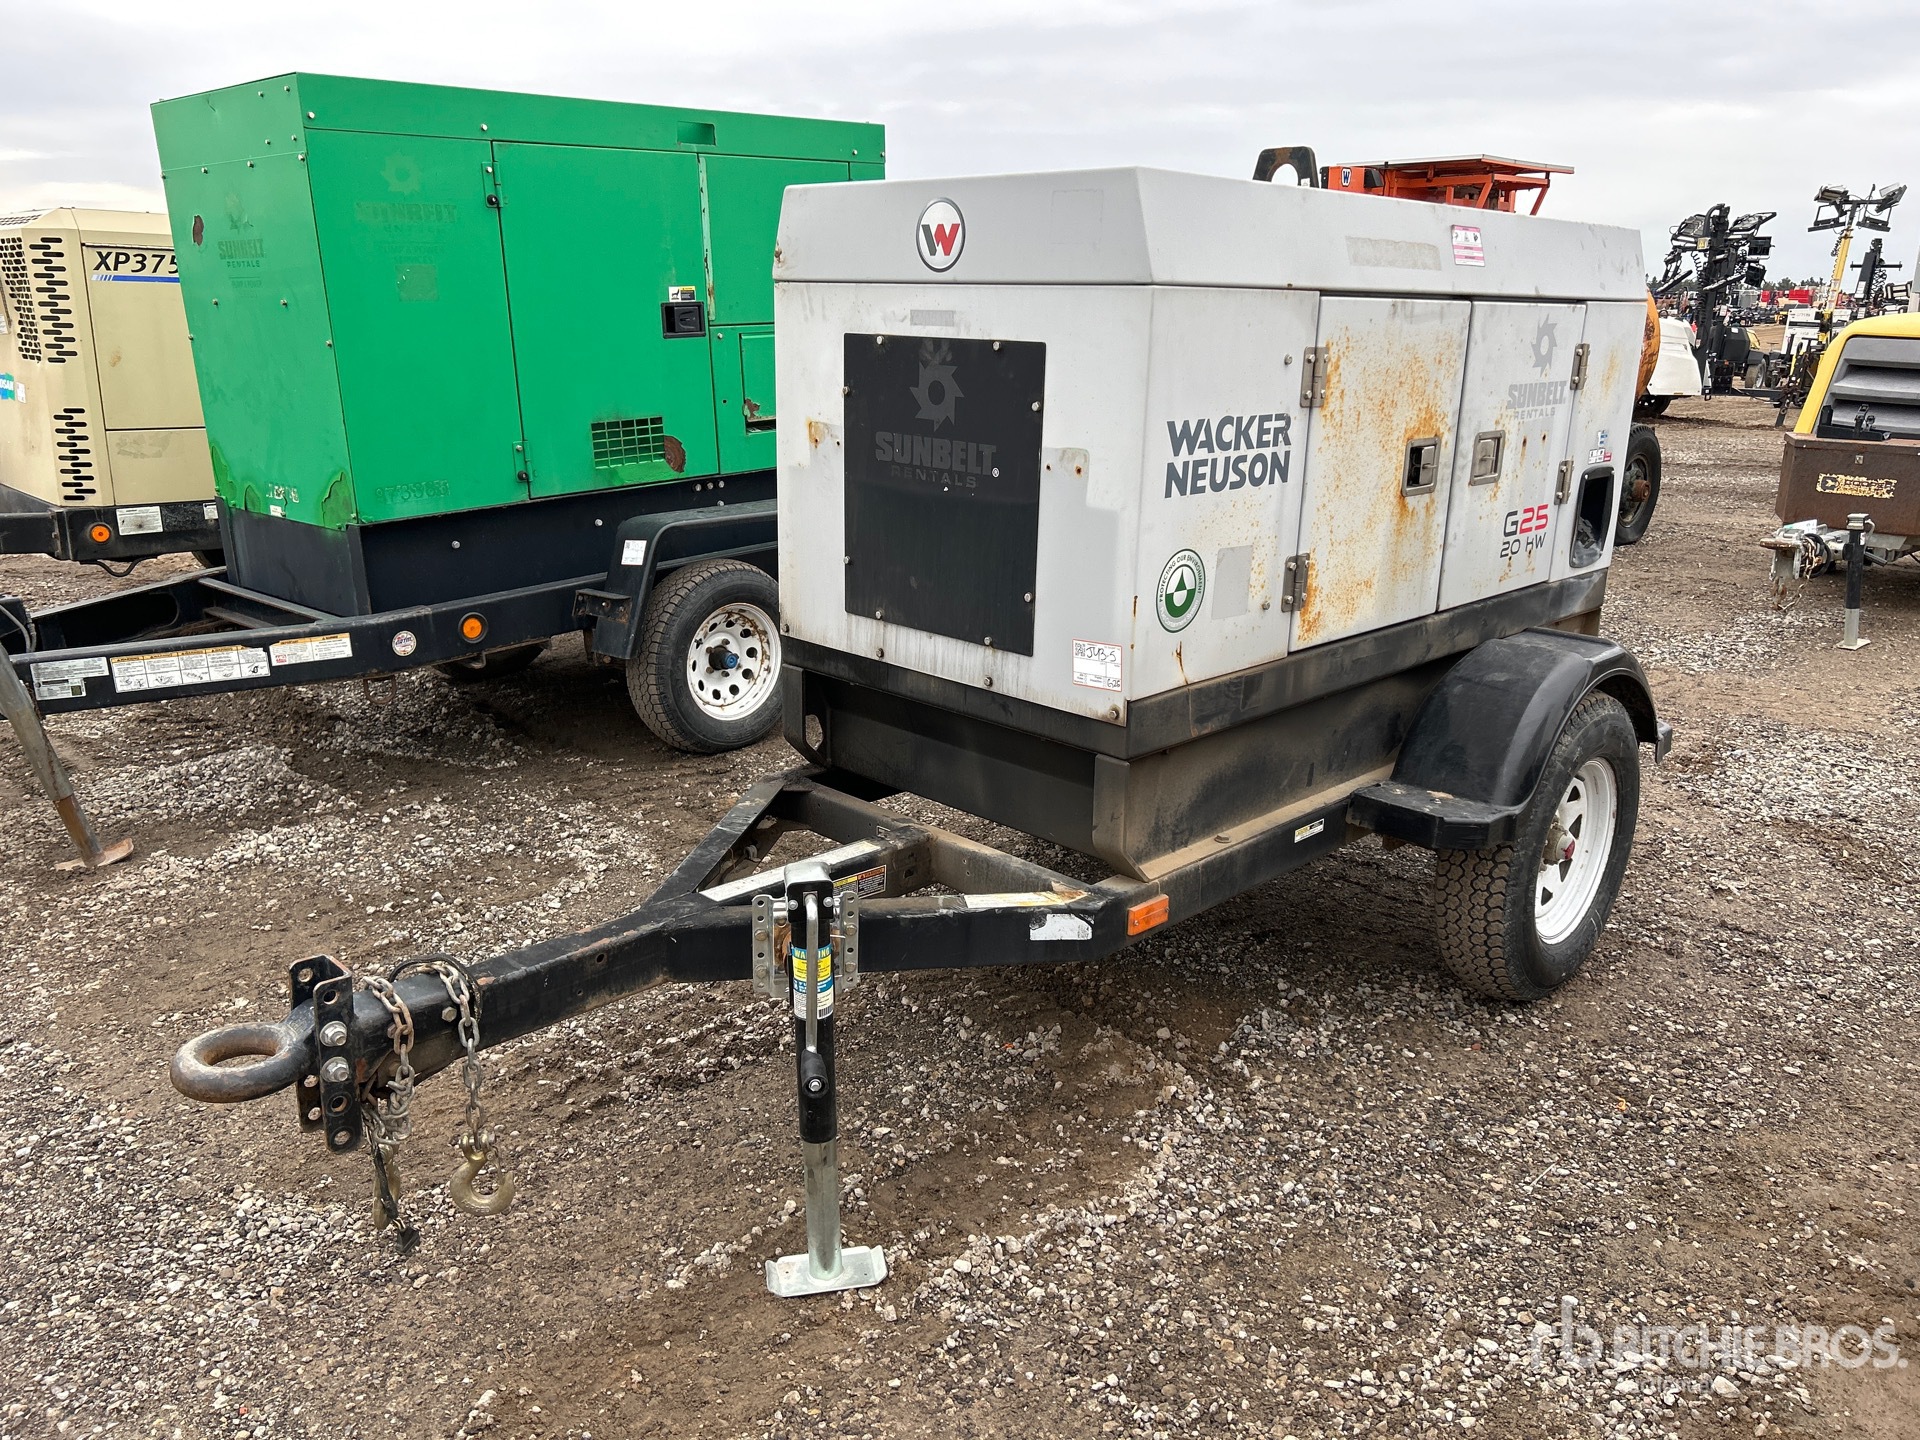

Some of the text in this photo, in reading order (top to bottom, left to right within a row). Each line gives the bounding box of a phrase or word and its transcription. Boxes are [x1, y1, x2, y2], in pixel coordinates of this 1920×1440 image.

[921, 223, 960, 257] W
[93, 250, 179, 274] XP375
[1507, 381, 1567, 410] SUNBELT
[1513, 406, 1556, 420] RENTALS
[1166, 412, 1292, 457] WACKER
[875, 431, 997, 476] SUNBELT
[890, 464, 976, 489] RENTALS
[1164, 450, 1291, 499] NEUSON
[1503, 504, 1549, 538] G25
[1500, 539, 1521, 558] 20
[795, 946, 831, 960] WAING
